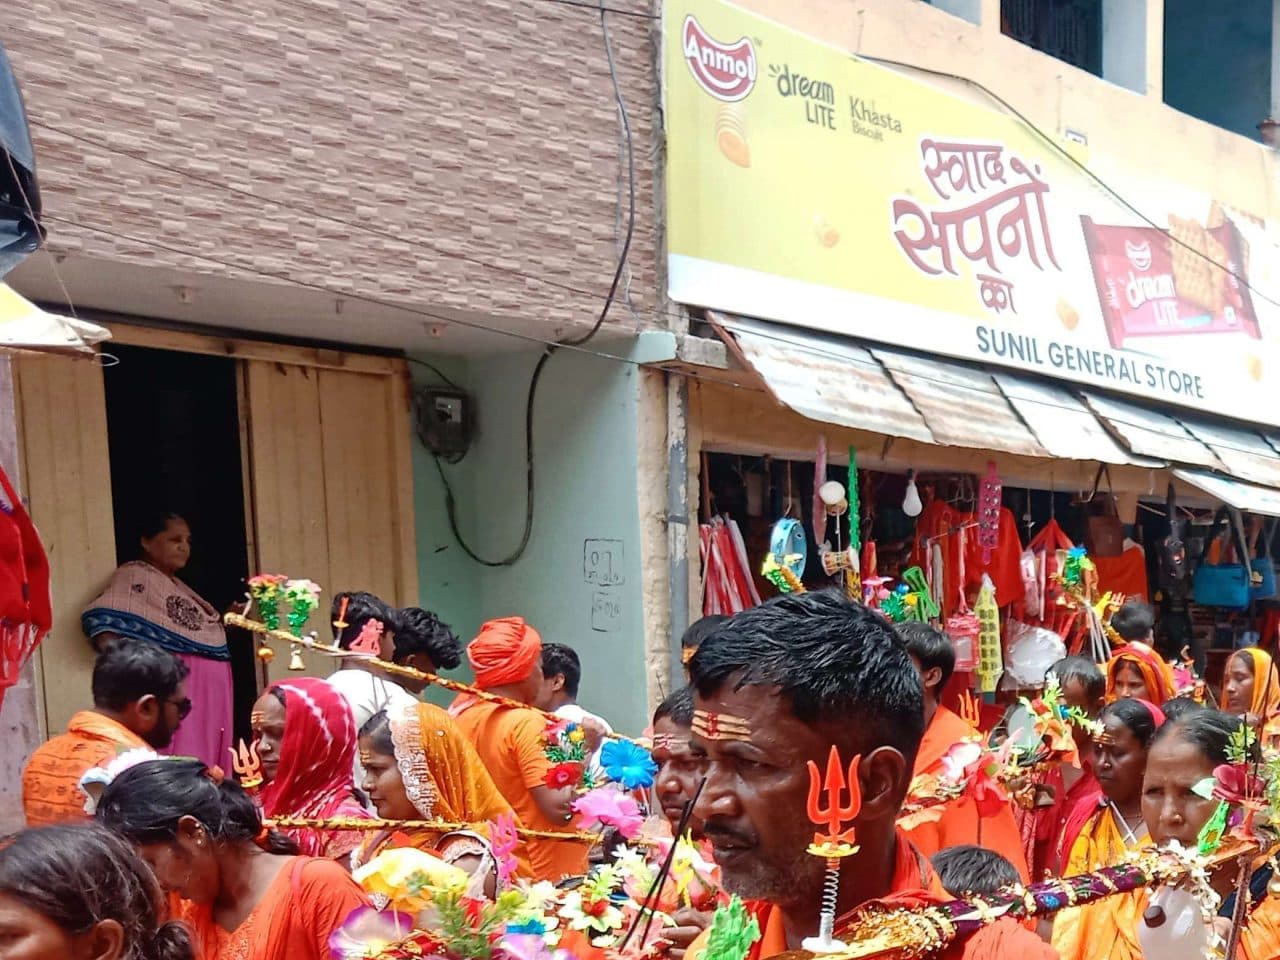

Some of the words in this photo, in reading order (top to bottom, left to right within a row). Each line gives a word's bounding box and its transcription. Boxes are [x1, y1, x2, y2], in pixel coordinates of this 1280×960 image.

[685, 35, 756, 82] Anmol
[777, 64, 835, 105] dream
[806, 102, 837, 130] LITE
[849, 96, 903, 134] Khasta
[921, 138, 1007, 200] स्वाद
[893, 156, 1062, 276] सपनों
[976, 273, 1018, 314] का
[976, 325, 1044, 365] SUNIL
[1048, 342, 1142, 385] GENERAL
[1145, 364, 1205, 399] STORE
